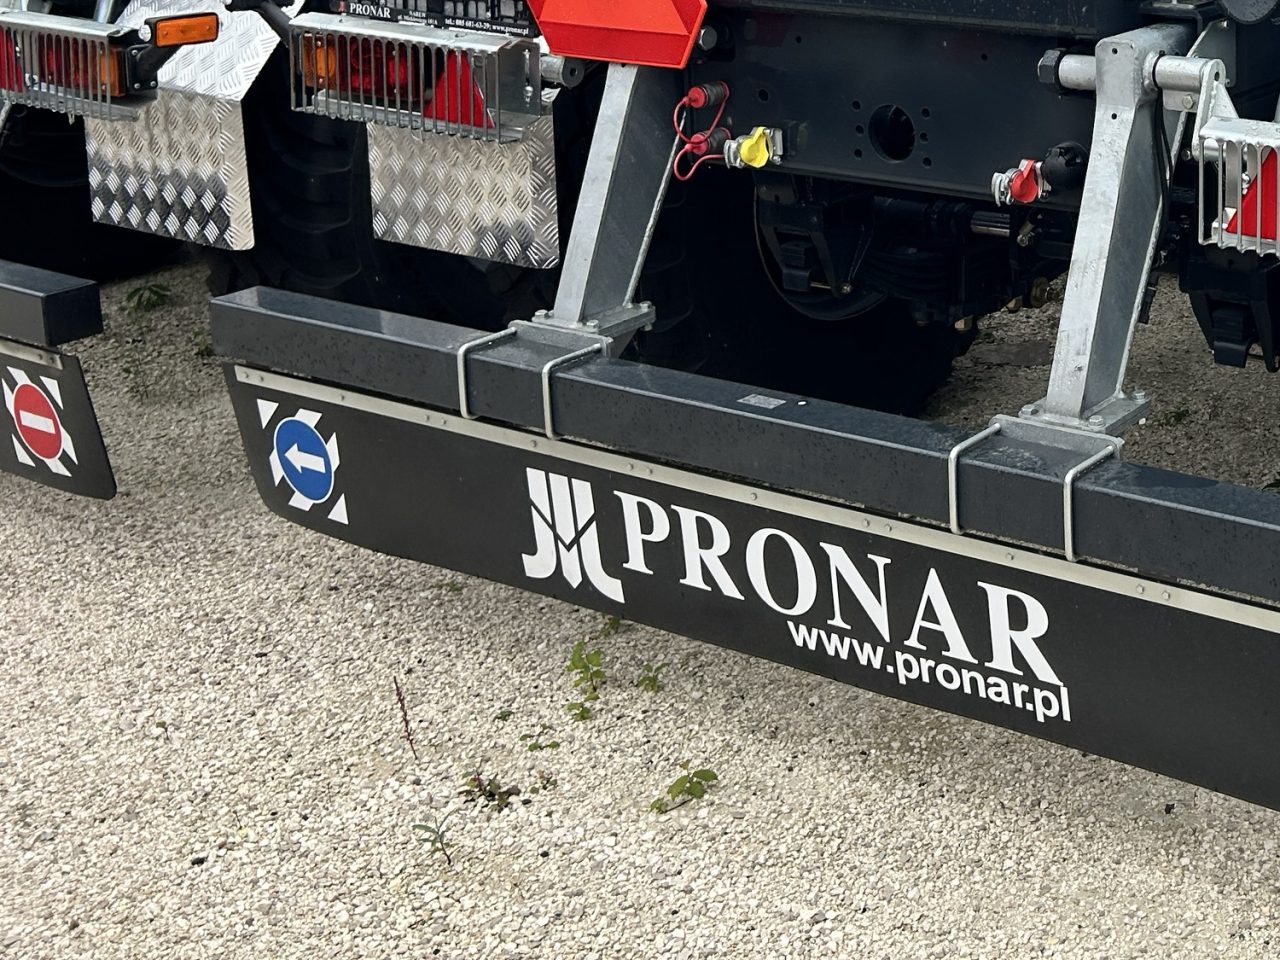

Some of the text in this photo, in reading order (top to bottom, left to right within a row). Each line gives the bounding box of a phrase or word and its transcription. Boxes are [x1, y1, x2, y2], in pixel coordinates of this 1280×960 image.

[349, 2, 391, 19] PRONAR
[613, 489, 1063, 687] PRONAR
[787, 620, 1072, 723] www.pronar.pl
